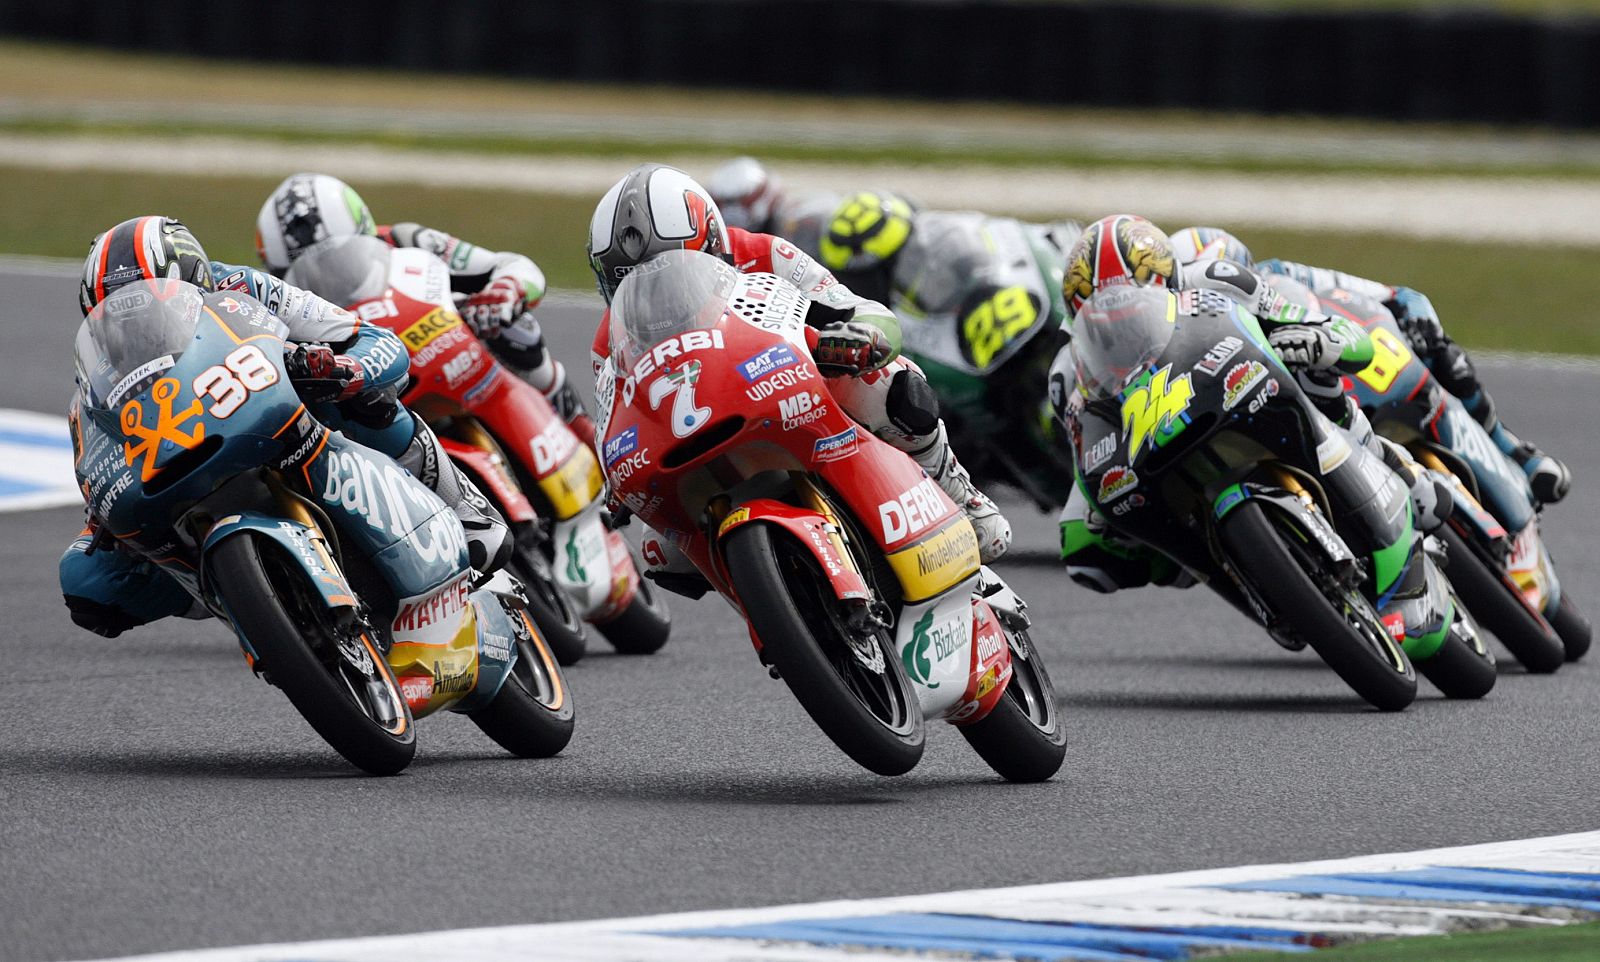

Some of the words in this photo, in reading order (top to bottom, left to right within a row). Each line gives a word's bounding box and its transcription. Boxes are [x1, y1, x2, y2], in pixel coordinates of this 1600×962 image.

[613, 254, 672, 278] SHARK
[108, 291, 146, 312] SHOEI
[407, 311, 457, 347] RACC
[963, 285, 1038, 369] 89
[193, 344, 278, 420] 38
[623, 330, 725, 407] DERBI
[745, 352, 772, 373] BAT
[750, 363, 775, 379] BASQUE
[775, 355, 793, 368] TEAM
[109, 365, 151, 404] PROFILTEK
[649, 359, 712, 439] 7
[1249, 389, 1269, 413] elf
[783, 405, 827, 431] Conveyors
[1121, 363, 1196, 466] 24
[280, 426, 322, 469] PROFILTEK
[878, 480, 948, 544] DERBI
[917, 529, 976, 577] MinuteMachine
[393, 574, 469, 632] MAPFRE
[931, 615, 968, 662] Bizkaia
[402, 680, 433, 703] aprilia
